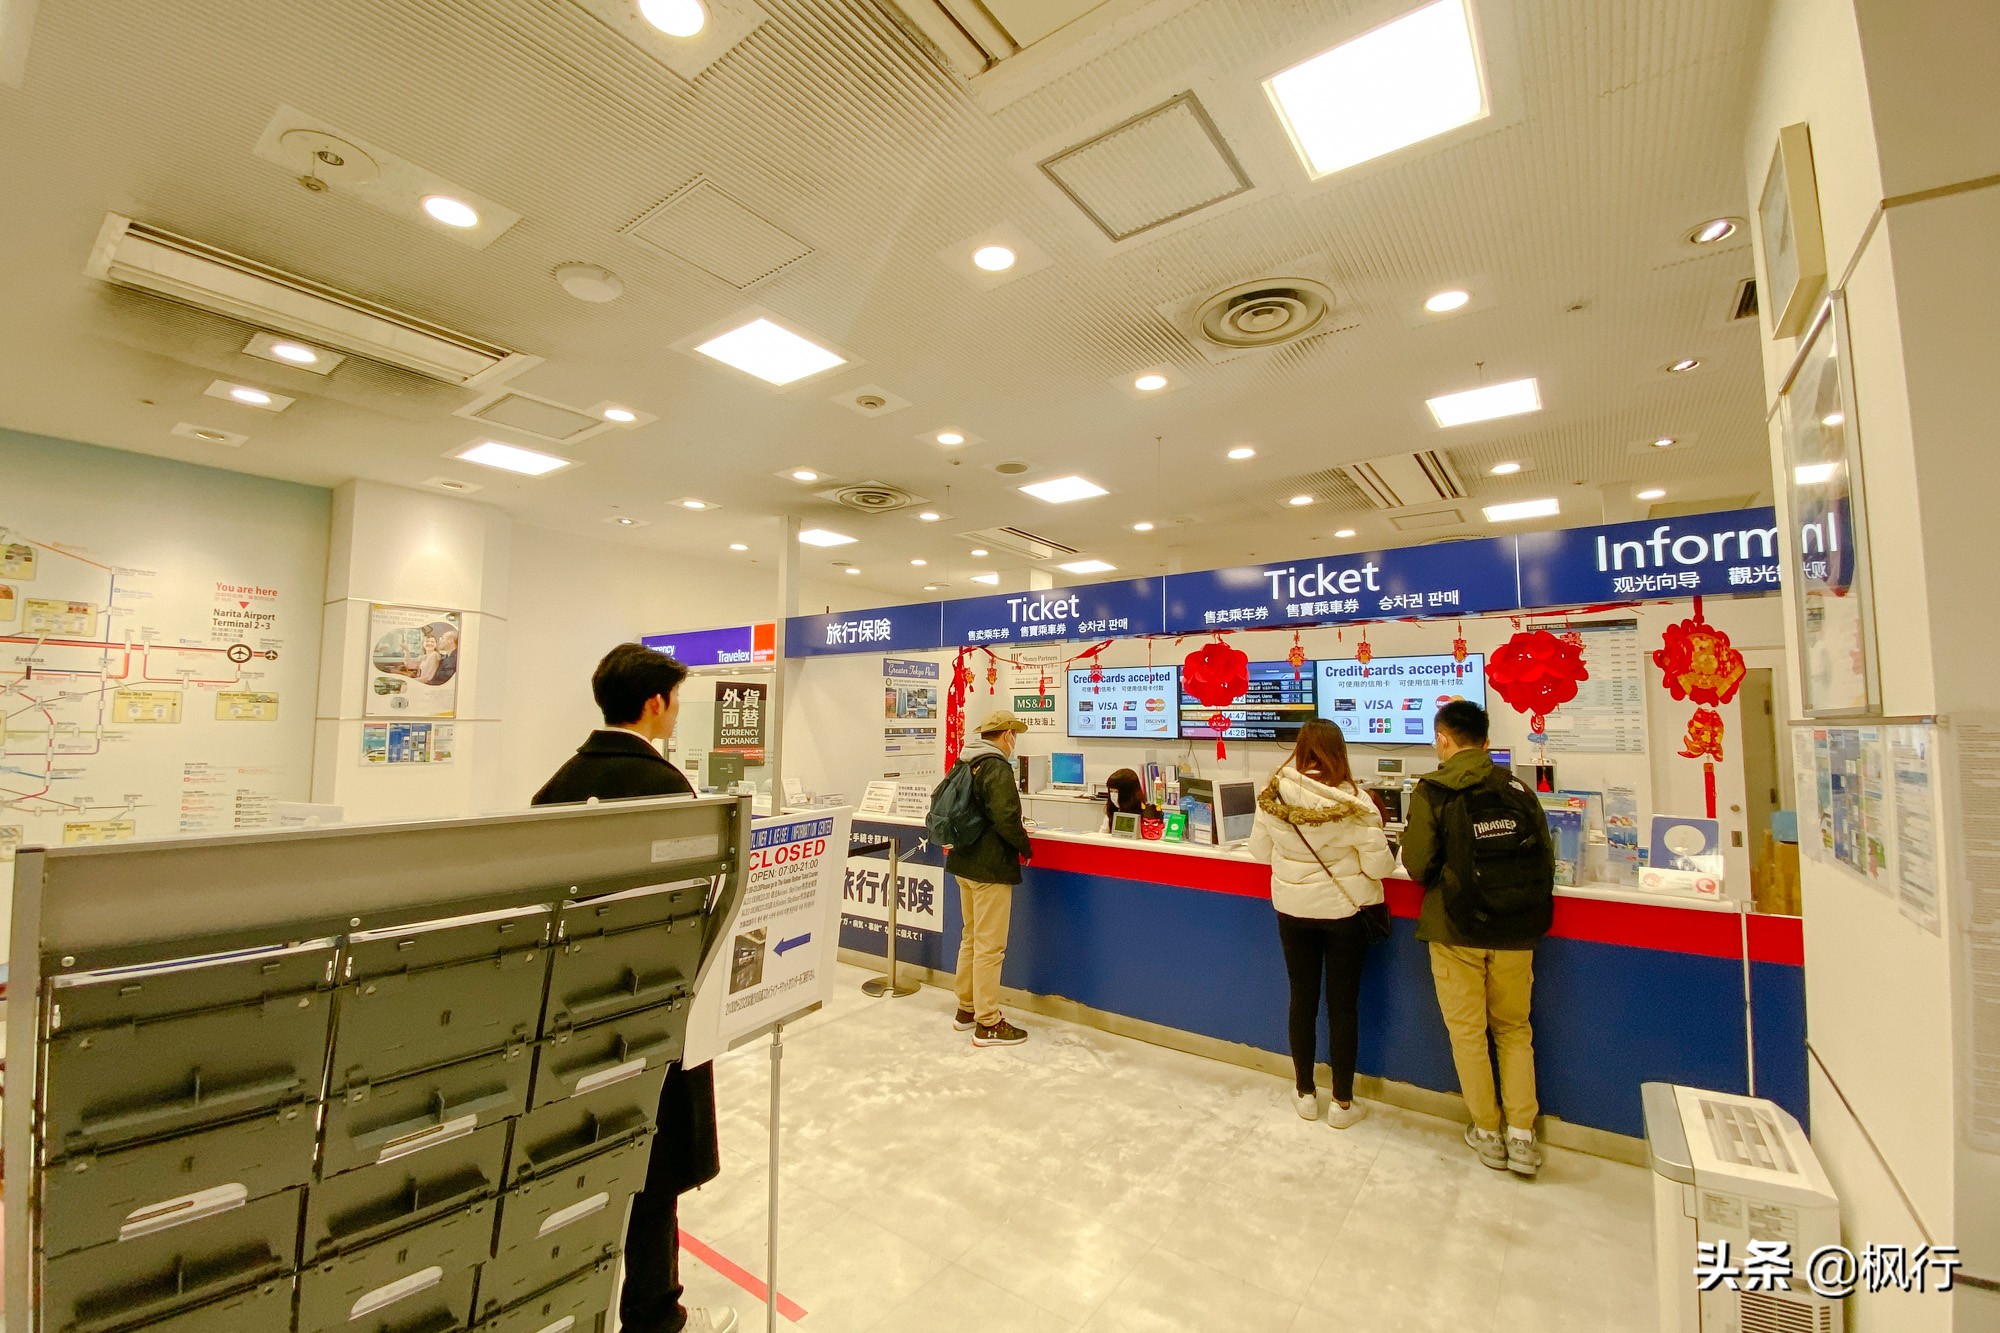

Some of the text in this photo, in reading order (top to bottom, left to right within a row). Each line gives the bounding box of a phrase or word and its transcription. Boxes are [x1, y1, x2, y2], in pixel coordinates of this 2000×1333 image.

[1264, 562, 1380, 599] Ticket
[1613, 565, 1781, 593] 观光向导 觀光
[216, 582, 234, 592] You
[256, 586, 278, 597] here
[1378, 589, 1460, 611] 승차권 판매
[1007, 593, 1080, 622] Ticket
[1204, 599, 1360, 624] 售卖乘车券 售賣乘車券
[213, 608, 276, 622] Narita Airport
[212, 618, 253, 629] Terminal
[1078, 617, 1128, 634] 승차권 판매
[826, 617, 892, 645] 旅行保険
[967, 623, 1067, 642] 售卖乘车券 售賣乘車券
[718, 649, 751, 663] Travelex
[888, 663, 908, 676] Greater
[909, 665, 924, 677] Tokyo
[1325, 661, 1473, 677] Credit cards acceptd
[1101, 673, 1126, 684] cards
[1338, 678, 1464, 688] 可使用的信用卡 可使用信用卡付款
[722, 688, 760, 708] 外貨
[1017, 698, 1053, 709] MS&D
[1363, 699, 1393, 710] VISA
[1098, 702, 1118, 711] VISA
[722, 708, 759, 728] 両替
[1016, 717, 1056, 726] 井住友海上
[1369, 719, 1391, 731] JCB
[721, 729, 759, 737] CURRENCY
[1223, 729, 1246, 737] 14:28
[720, 737, 759, 745] EXCHANGE
[749, 839, 826, 871] CLOSED
[750, 858, 819, 883] OPEN: 07:00-21:00
